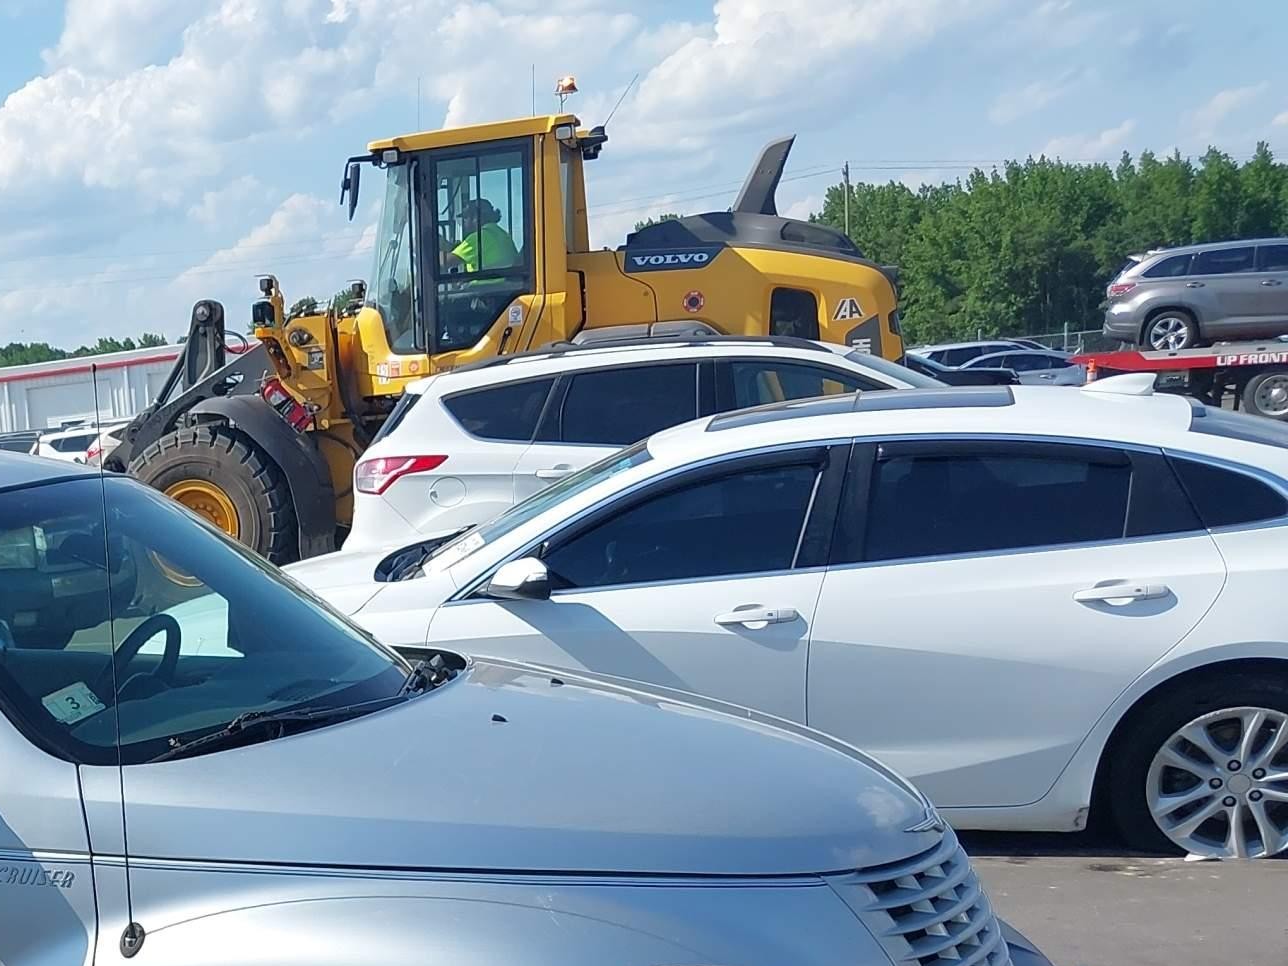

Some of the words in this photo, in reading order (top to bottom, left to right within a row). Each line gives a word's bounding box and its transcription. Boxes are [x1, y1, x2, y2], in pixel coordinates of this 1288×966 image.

[632, 252, 709, 266] VOLVO
[1216, 355, 1239, 367] UP
[1239, 352, 1288, 366] FRONT
[65, 696, 81, 710] 3
